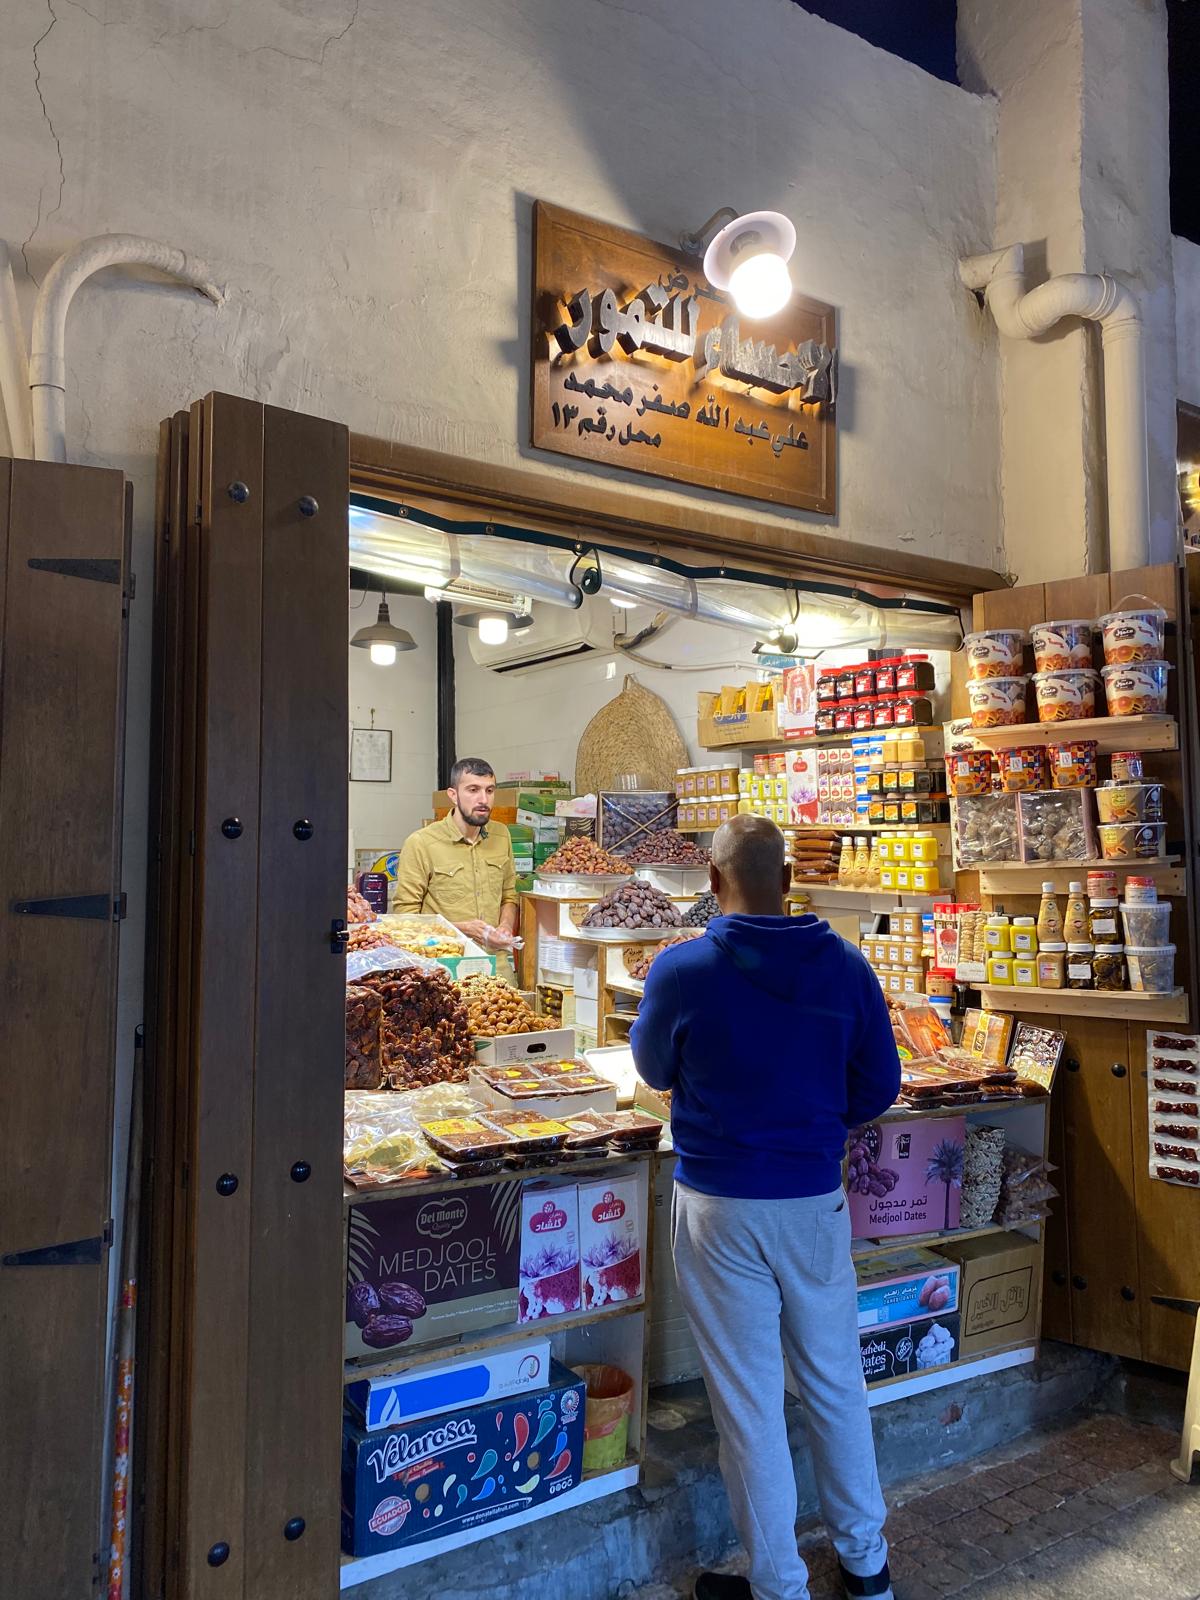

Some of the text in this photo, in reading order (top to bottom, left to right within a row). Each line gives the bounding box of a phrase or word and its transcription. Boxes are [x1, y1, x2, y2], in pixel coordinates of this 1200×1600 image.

[554, 283, 700, 362] للتمور
[563, 371, 809, 457] علي عبد الله صفر محمد
[578, 407, 616, 441] رقم
[618, 422, 662, 449] محل
[420, 1208, 465, 1225] Del Monte
[869, 1195, 928, 1211] تمر مدجول
[869, 1211, 927, 1225] Medjool Dates
[378, 1237, 497, 1277] MEDJOOL
[424, 1258, 496, 1292] DATES
[367, 1418, 477, 1483] Velarosa
[371, 1502, 410, 1530] ECUADOR
